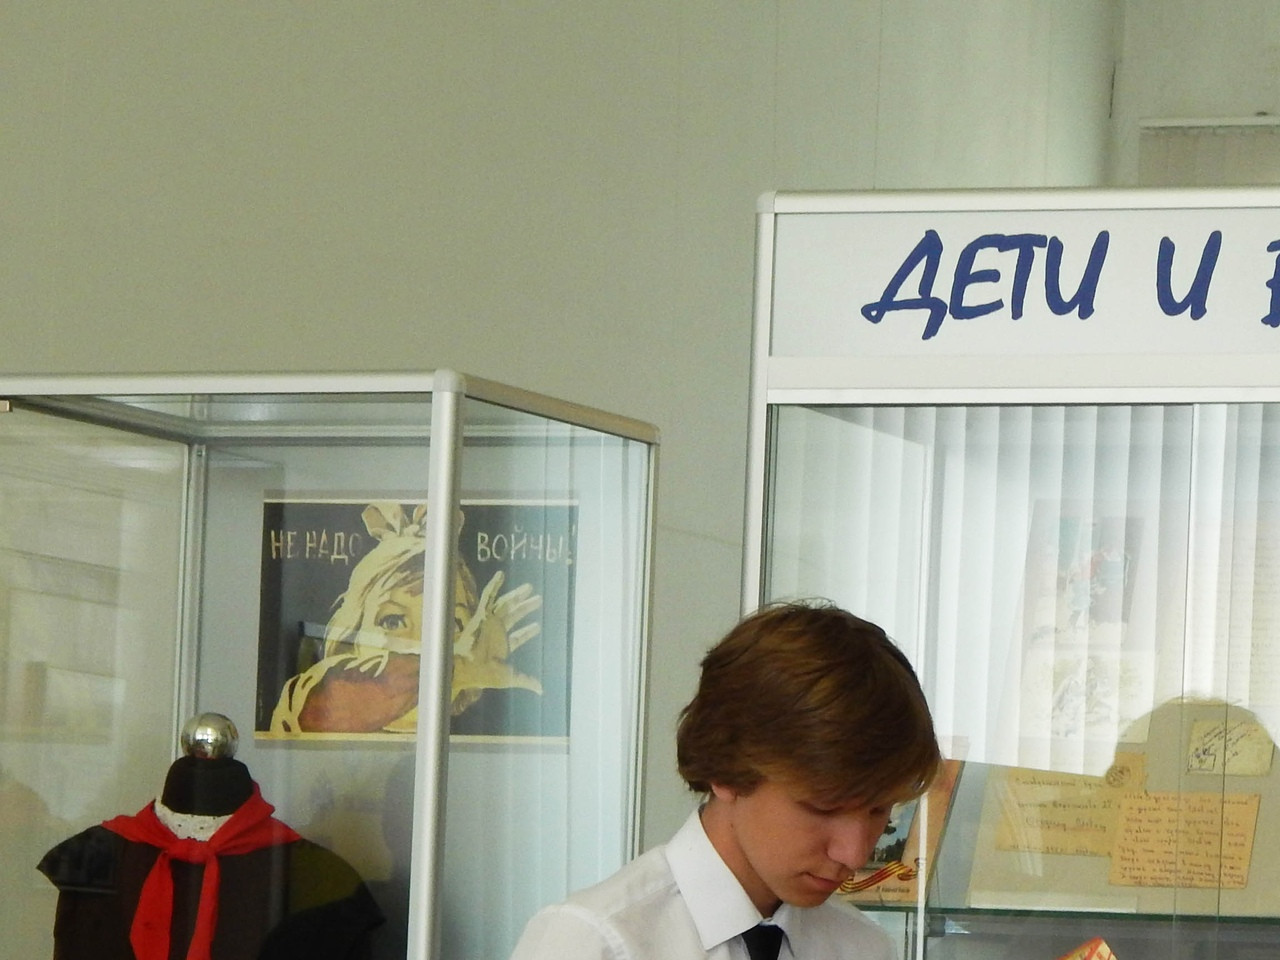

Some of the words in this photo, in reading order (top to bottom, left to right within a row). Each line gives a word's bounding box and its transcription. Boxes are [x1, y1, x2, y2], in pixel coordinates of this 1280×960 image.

[861, 227, 1110, 341] ДЕТИ
[1156, 229, 1222, 320] И
[270, 529, 297, 561] НЕ
[305, 528, 363, 566] НАДО
[476, 523, 577, 566] ВОЙНЫ!
